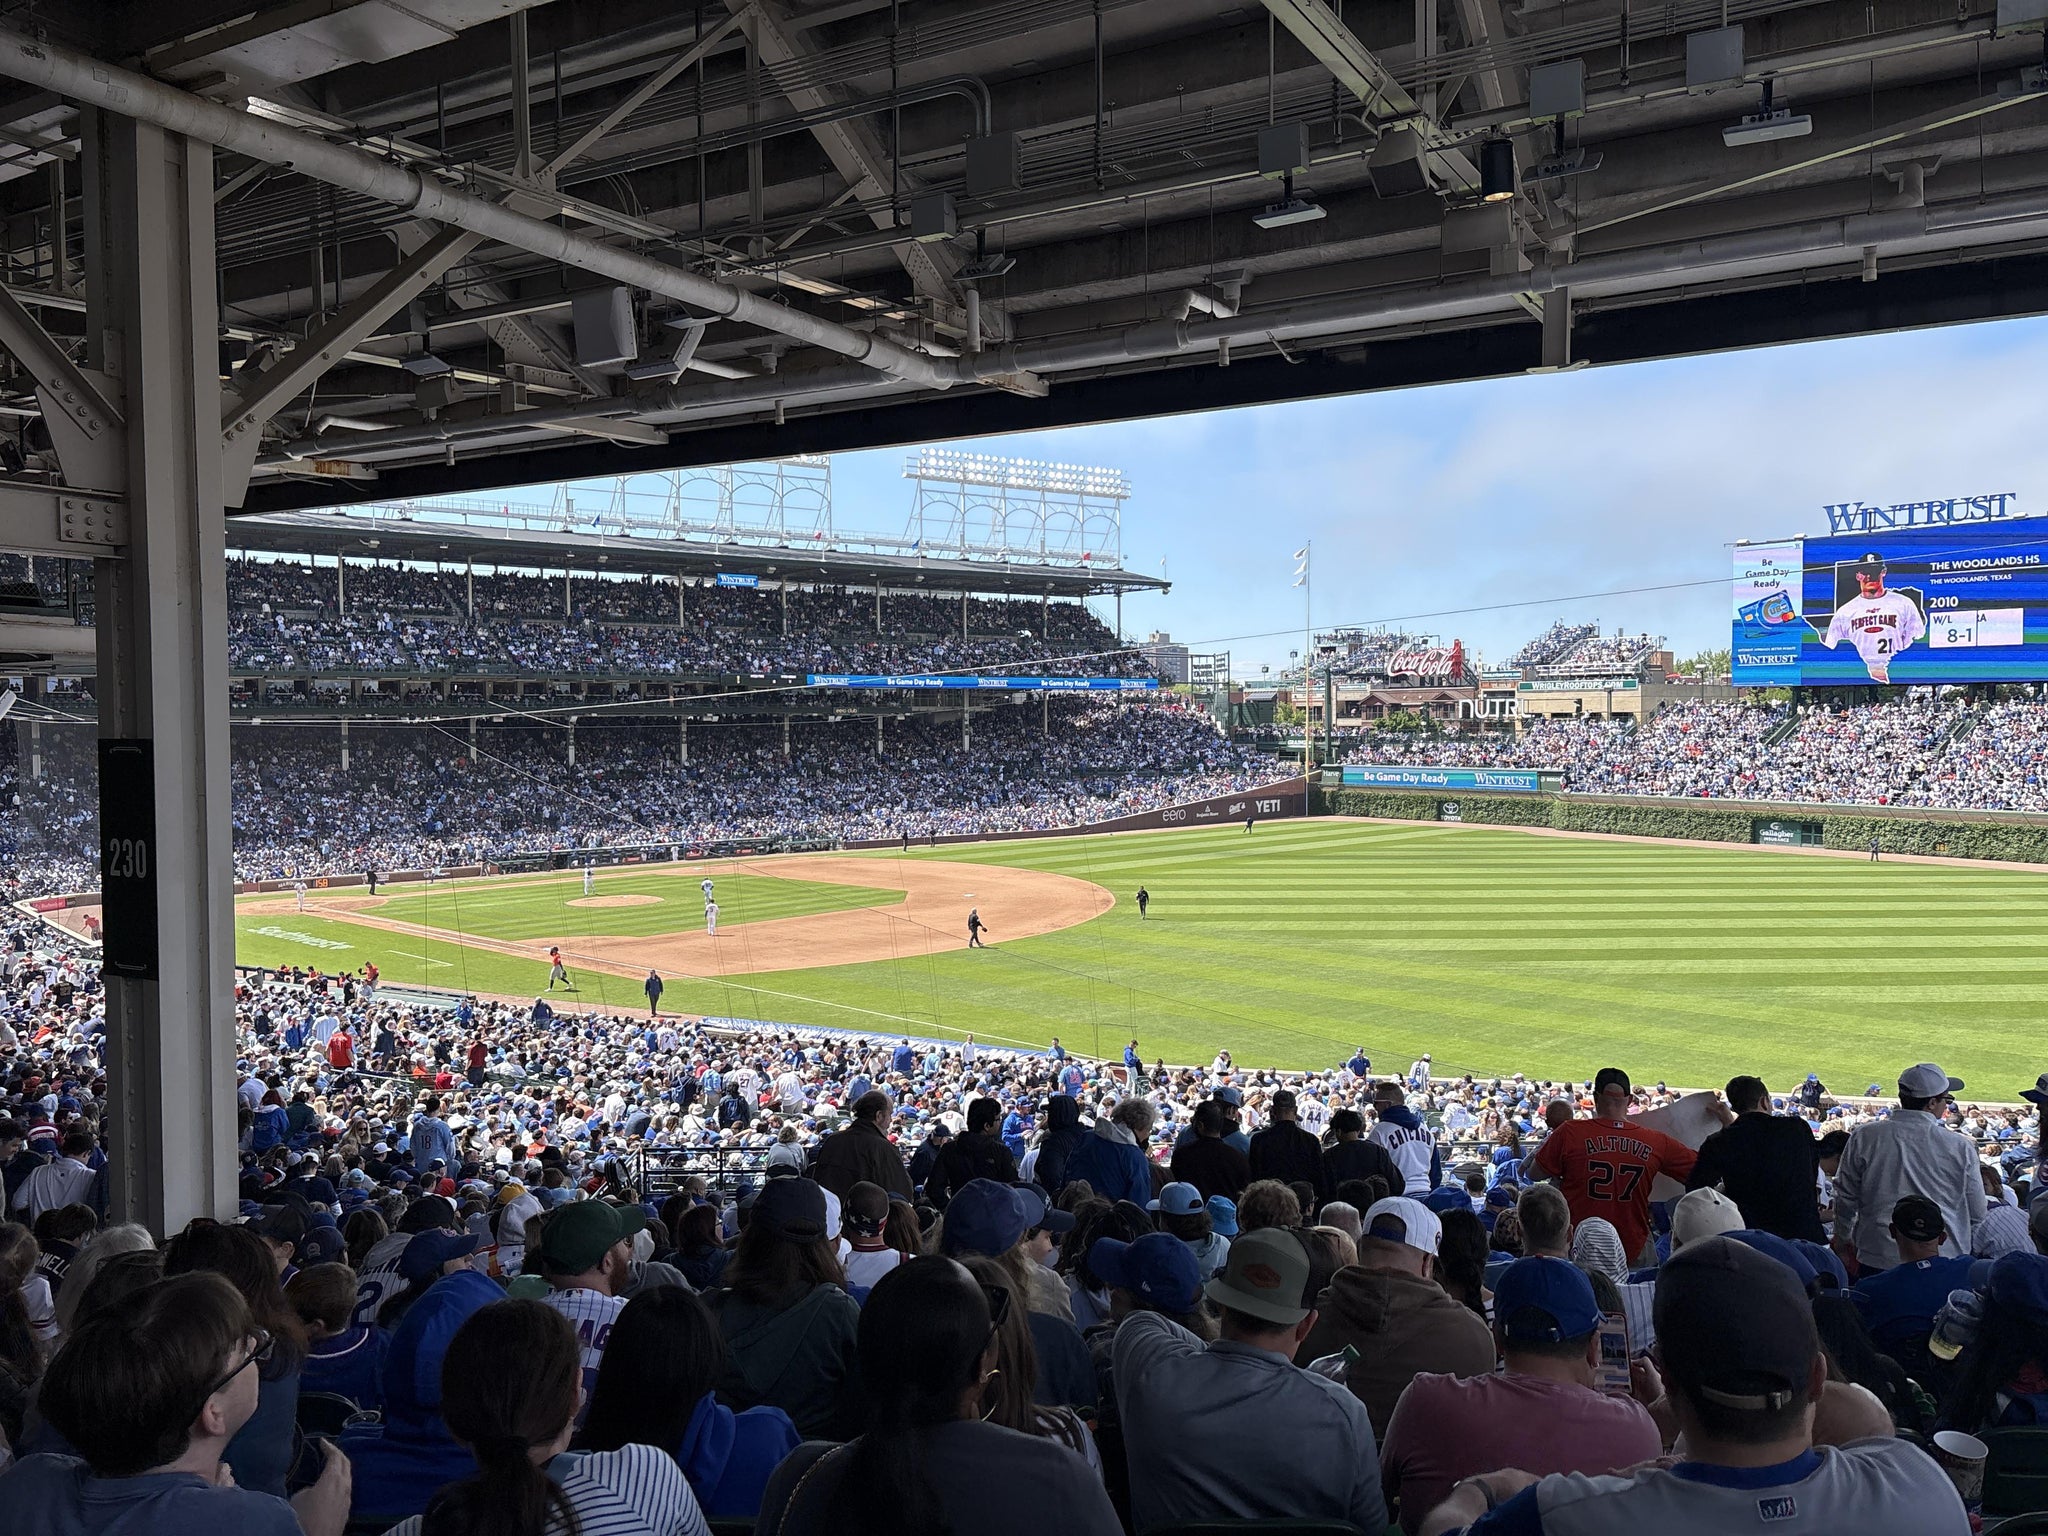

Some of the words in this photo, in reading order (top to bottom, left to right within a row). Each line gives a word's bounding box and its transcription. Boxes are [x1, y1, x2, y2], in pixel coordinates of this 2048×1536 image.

[1823, 492, 2016, 533] WINTRUST
[1930, 562, 1950, 571] THE
[1952, 556, 2023, 568] WOODLANDS
[2025, 555, 2040, 563] HS
[1754, 579, 1781, 588] Ready
[1930, 596, 1959, 608] 2010
[1933, 615, 1953, 626] W/L
[1947, 628, 1972, 643] 8-1
[1877, 638, 1893, 654] 21
[1386, 650, 1458, 677] Coca-Cola
[1738, 653, 1798, 664] WINTRUST
[926, 678, 944, 688] Ready
[1364, 772, 1375, 781] Be
[1376, 773, 1401, 782] Game
[1403, 774, 1420, 785] Day
[1421, 774, 1449, 786] Ready
[1475, 773, 1533, 785] WINTRUST
[1162, 809, 1187, 822] eero
[1255, 799, 1281, 813] YETI
[1760, 829, 1794, 838] Gallagher
[110, 839, 146, 878] 230
[1307, 1111, 1321, 1124] 44
[421, 1135, 432, 1149] 18
[1389, 1130, 1431, 1149] CHICAGO
[1585, 1136, 1653, 1161] ALTUVE
[1588, 1160, 1645, 1201] 27
